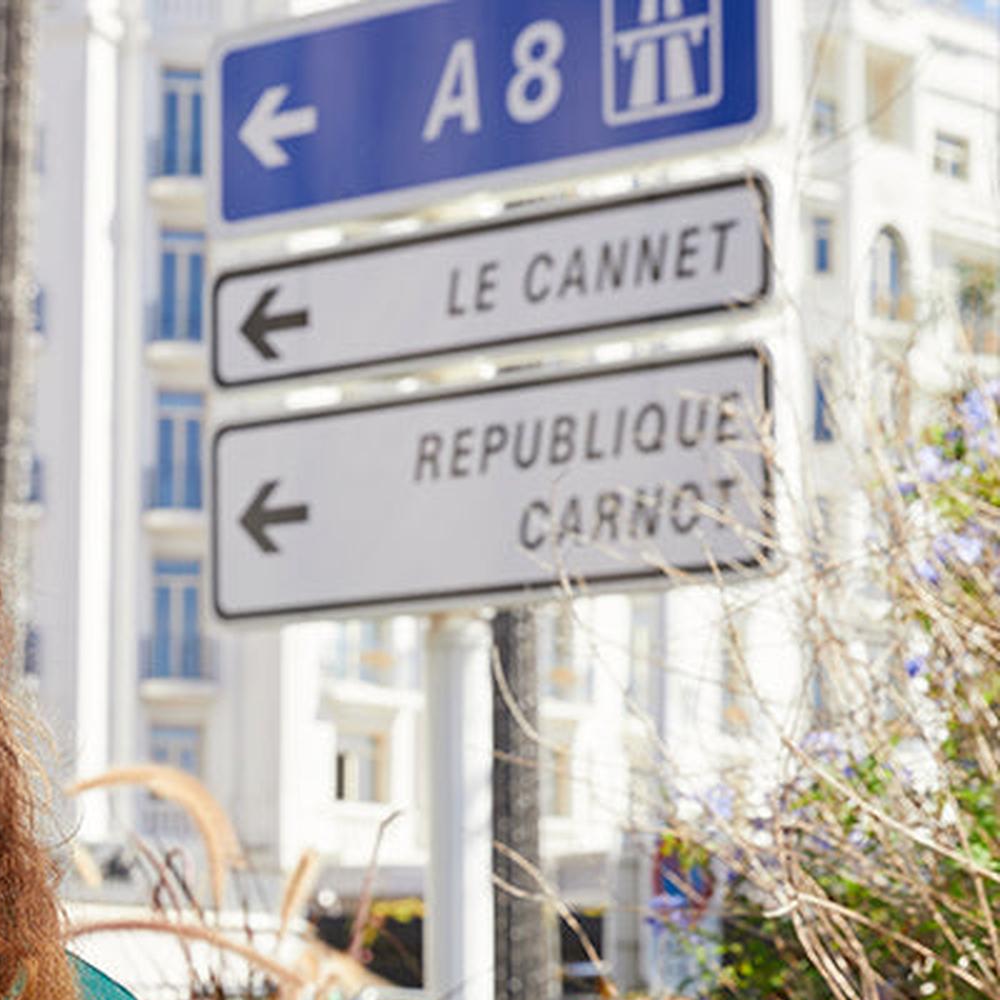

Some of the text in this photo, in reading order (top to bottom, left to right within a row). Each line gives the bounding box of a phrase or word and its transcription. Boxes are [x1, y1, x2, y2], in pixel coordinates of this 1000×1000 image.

[447, 219, 738, 316] LE CANNET
[413, 392, 741, 482] REPUBLIQUE
[518, 478, 740, 551] CARNOT
